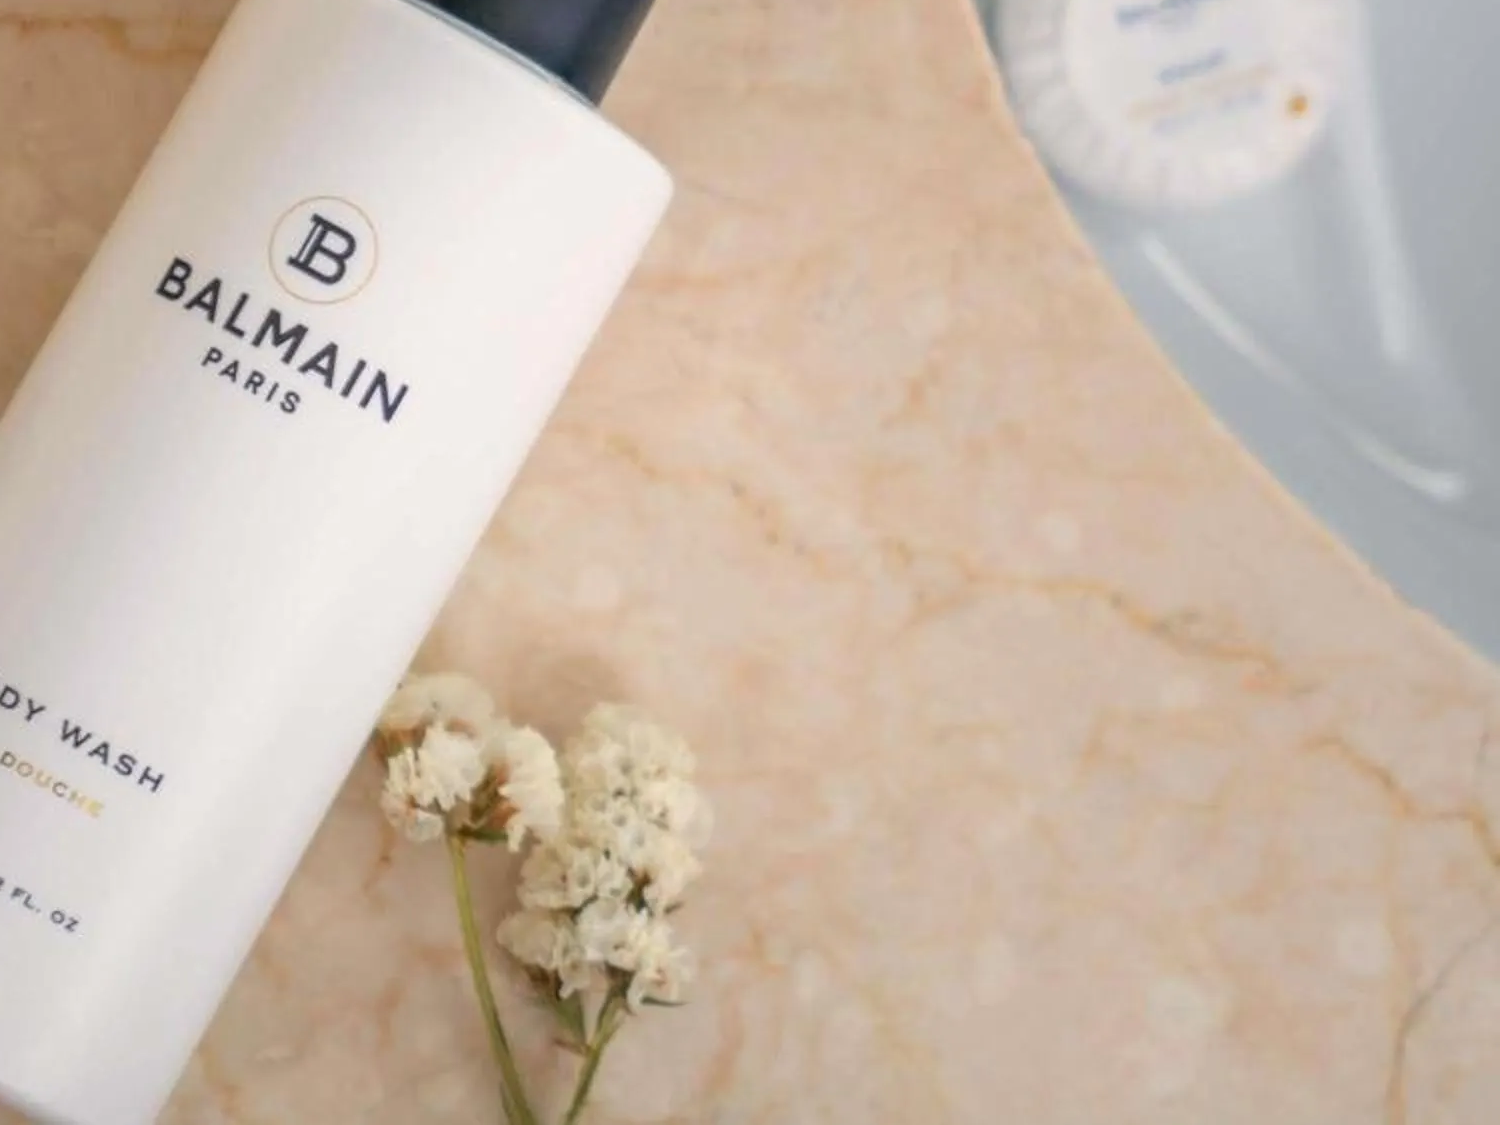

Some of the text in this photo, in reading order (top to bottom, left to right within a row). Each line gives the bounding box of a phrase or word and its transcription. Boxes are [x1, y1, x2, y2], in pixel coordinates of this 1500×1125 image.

[155, 257, 409, 423] BALMAIN
[201, 347, 301, 414] PARIS
[0, 750, 106, 819] DOUCHE
[59, 719, 165, 793] WASH
[10, 887, 41, 913] FL.
[49, 910, 80, 933] OZ
